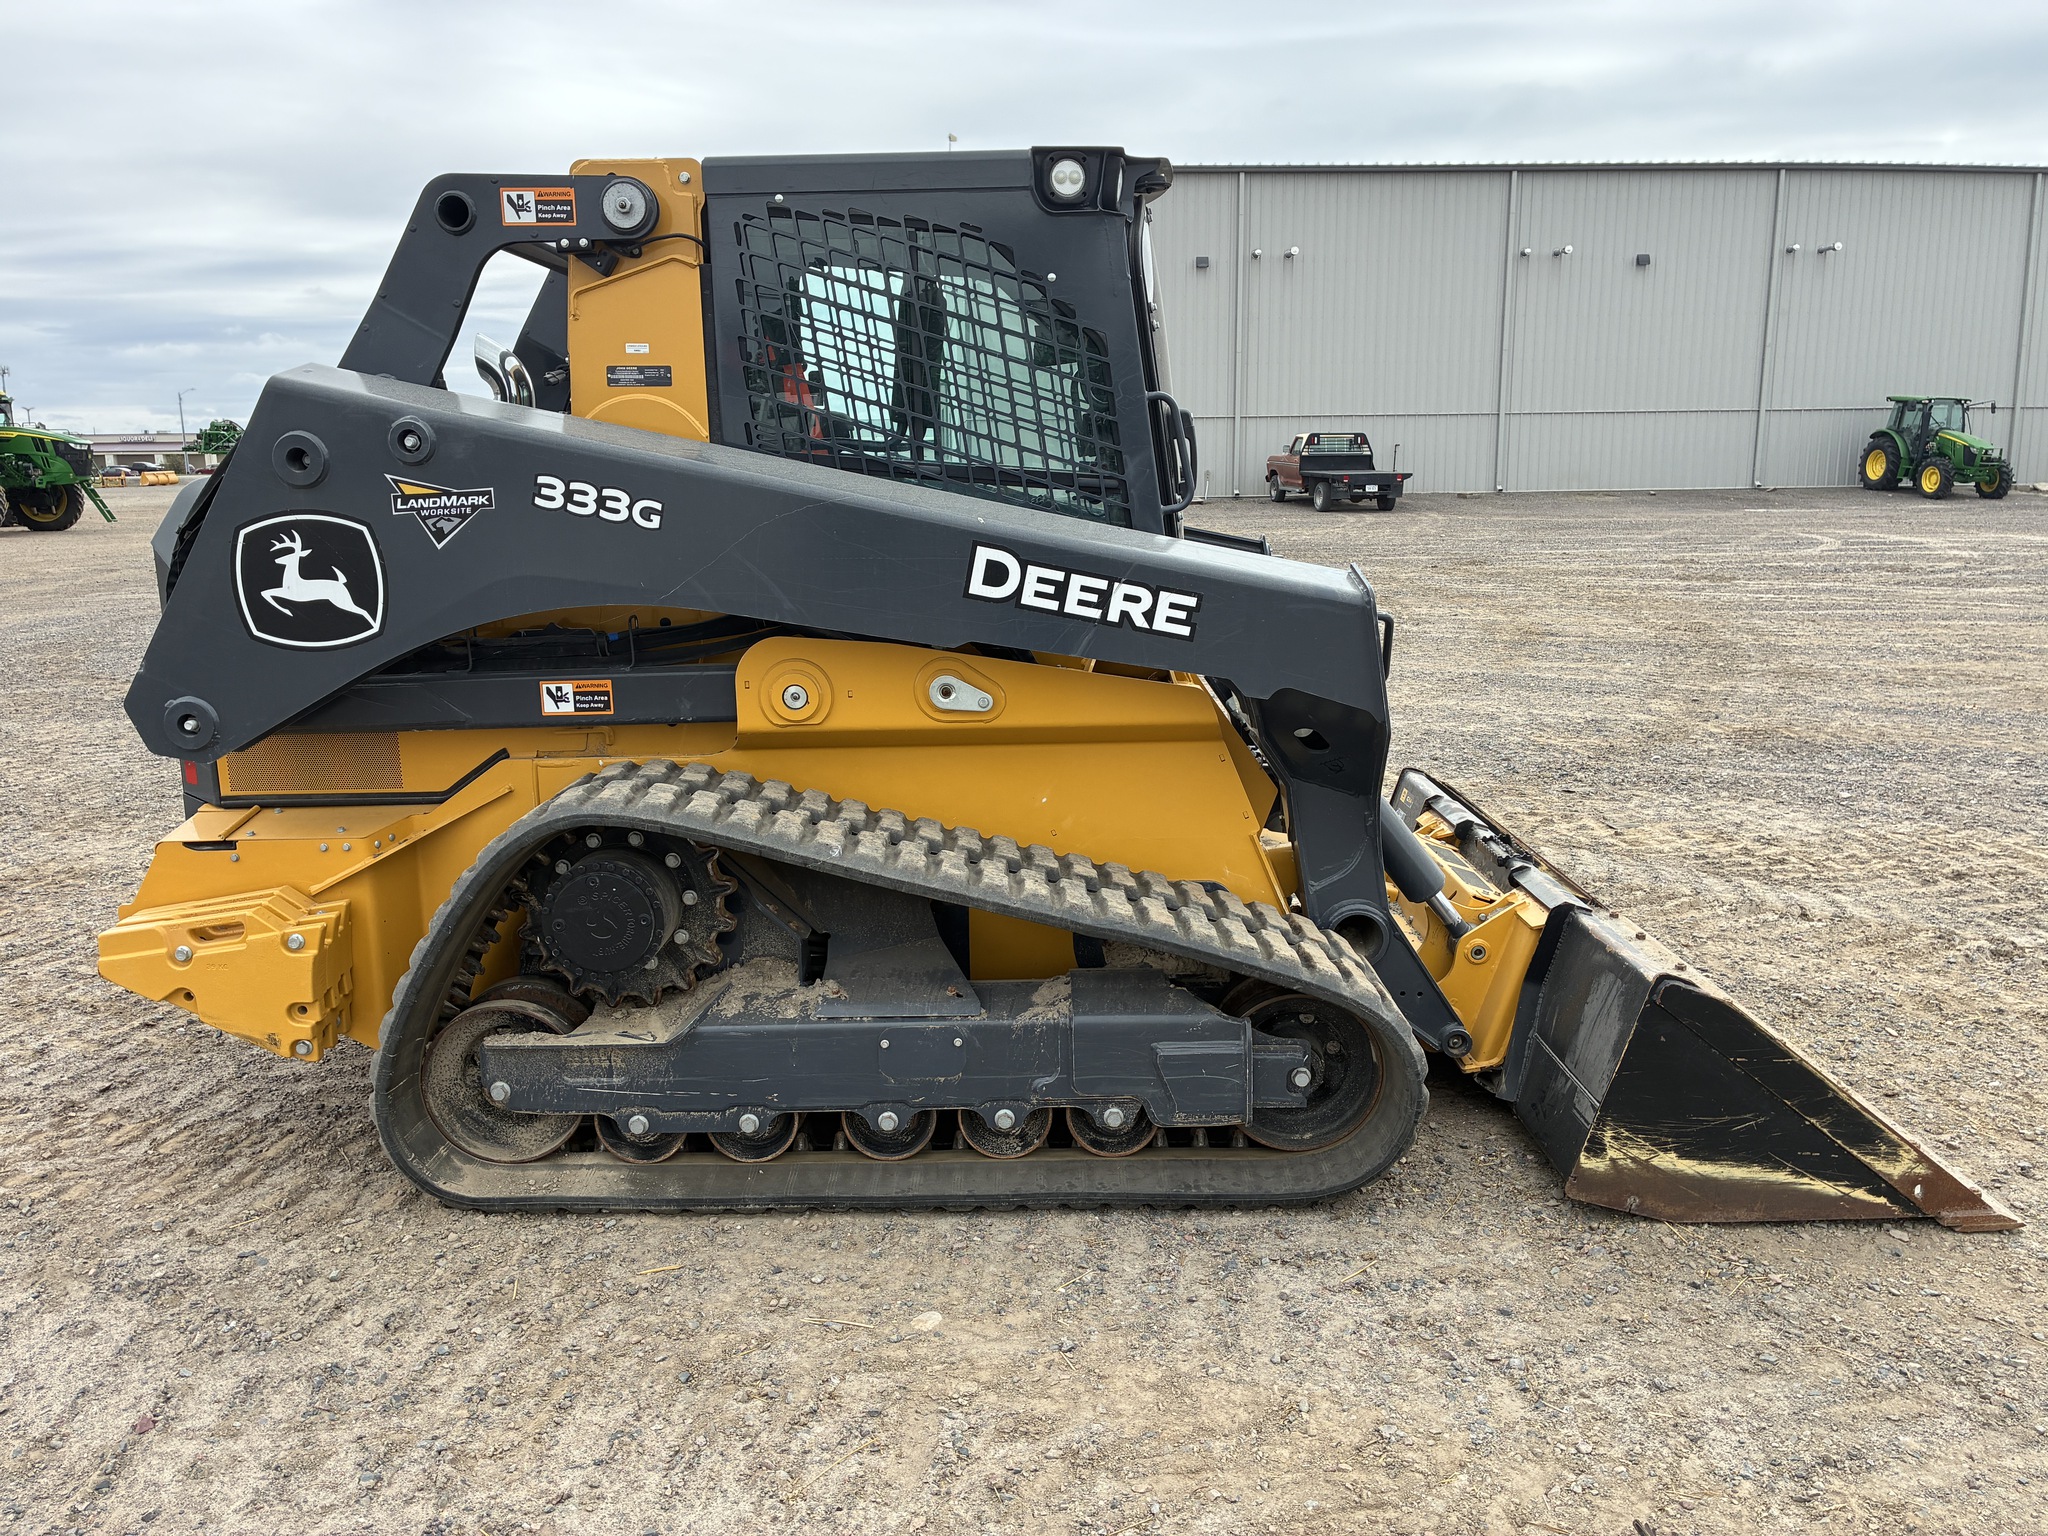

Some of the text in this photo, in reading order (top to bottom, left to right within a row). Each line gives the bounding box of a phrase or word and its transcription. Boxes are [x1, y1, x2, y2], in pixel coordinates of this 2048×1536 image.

[396, 495, 490, 509] LANDMARK
[420, 507, 472, 516] WORKSITE
[534, 475, 662, 529] 333G
[968, 545, 1198, 637] DEERE
[592, 892, 633, 916] SPICER
